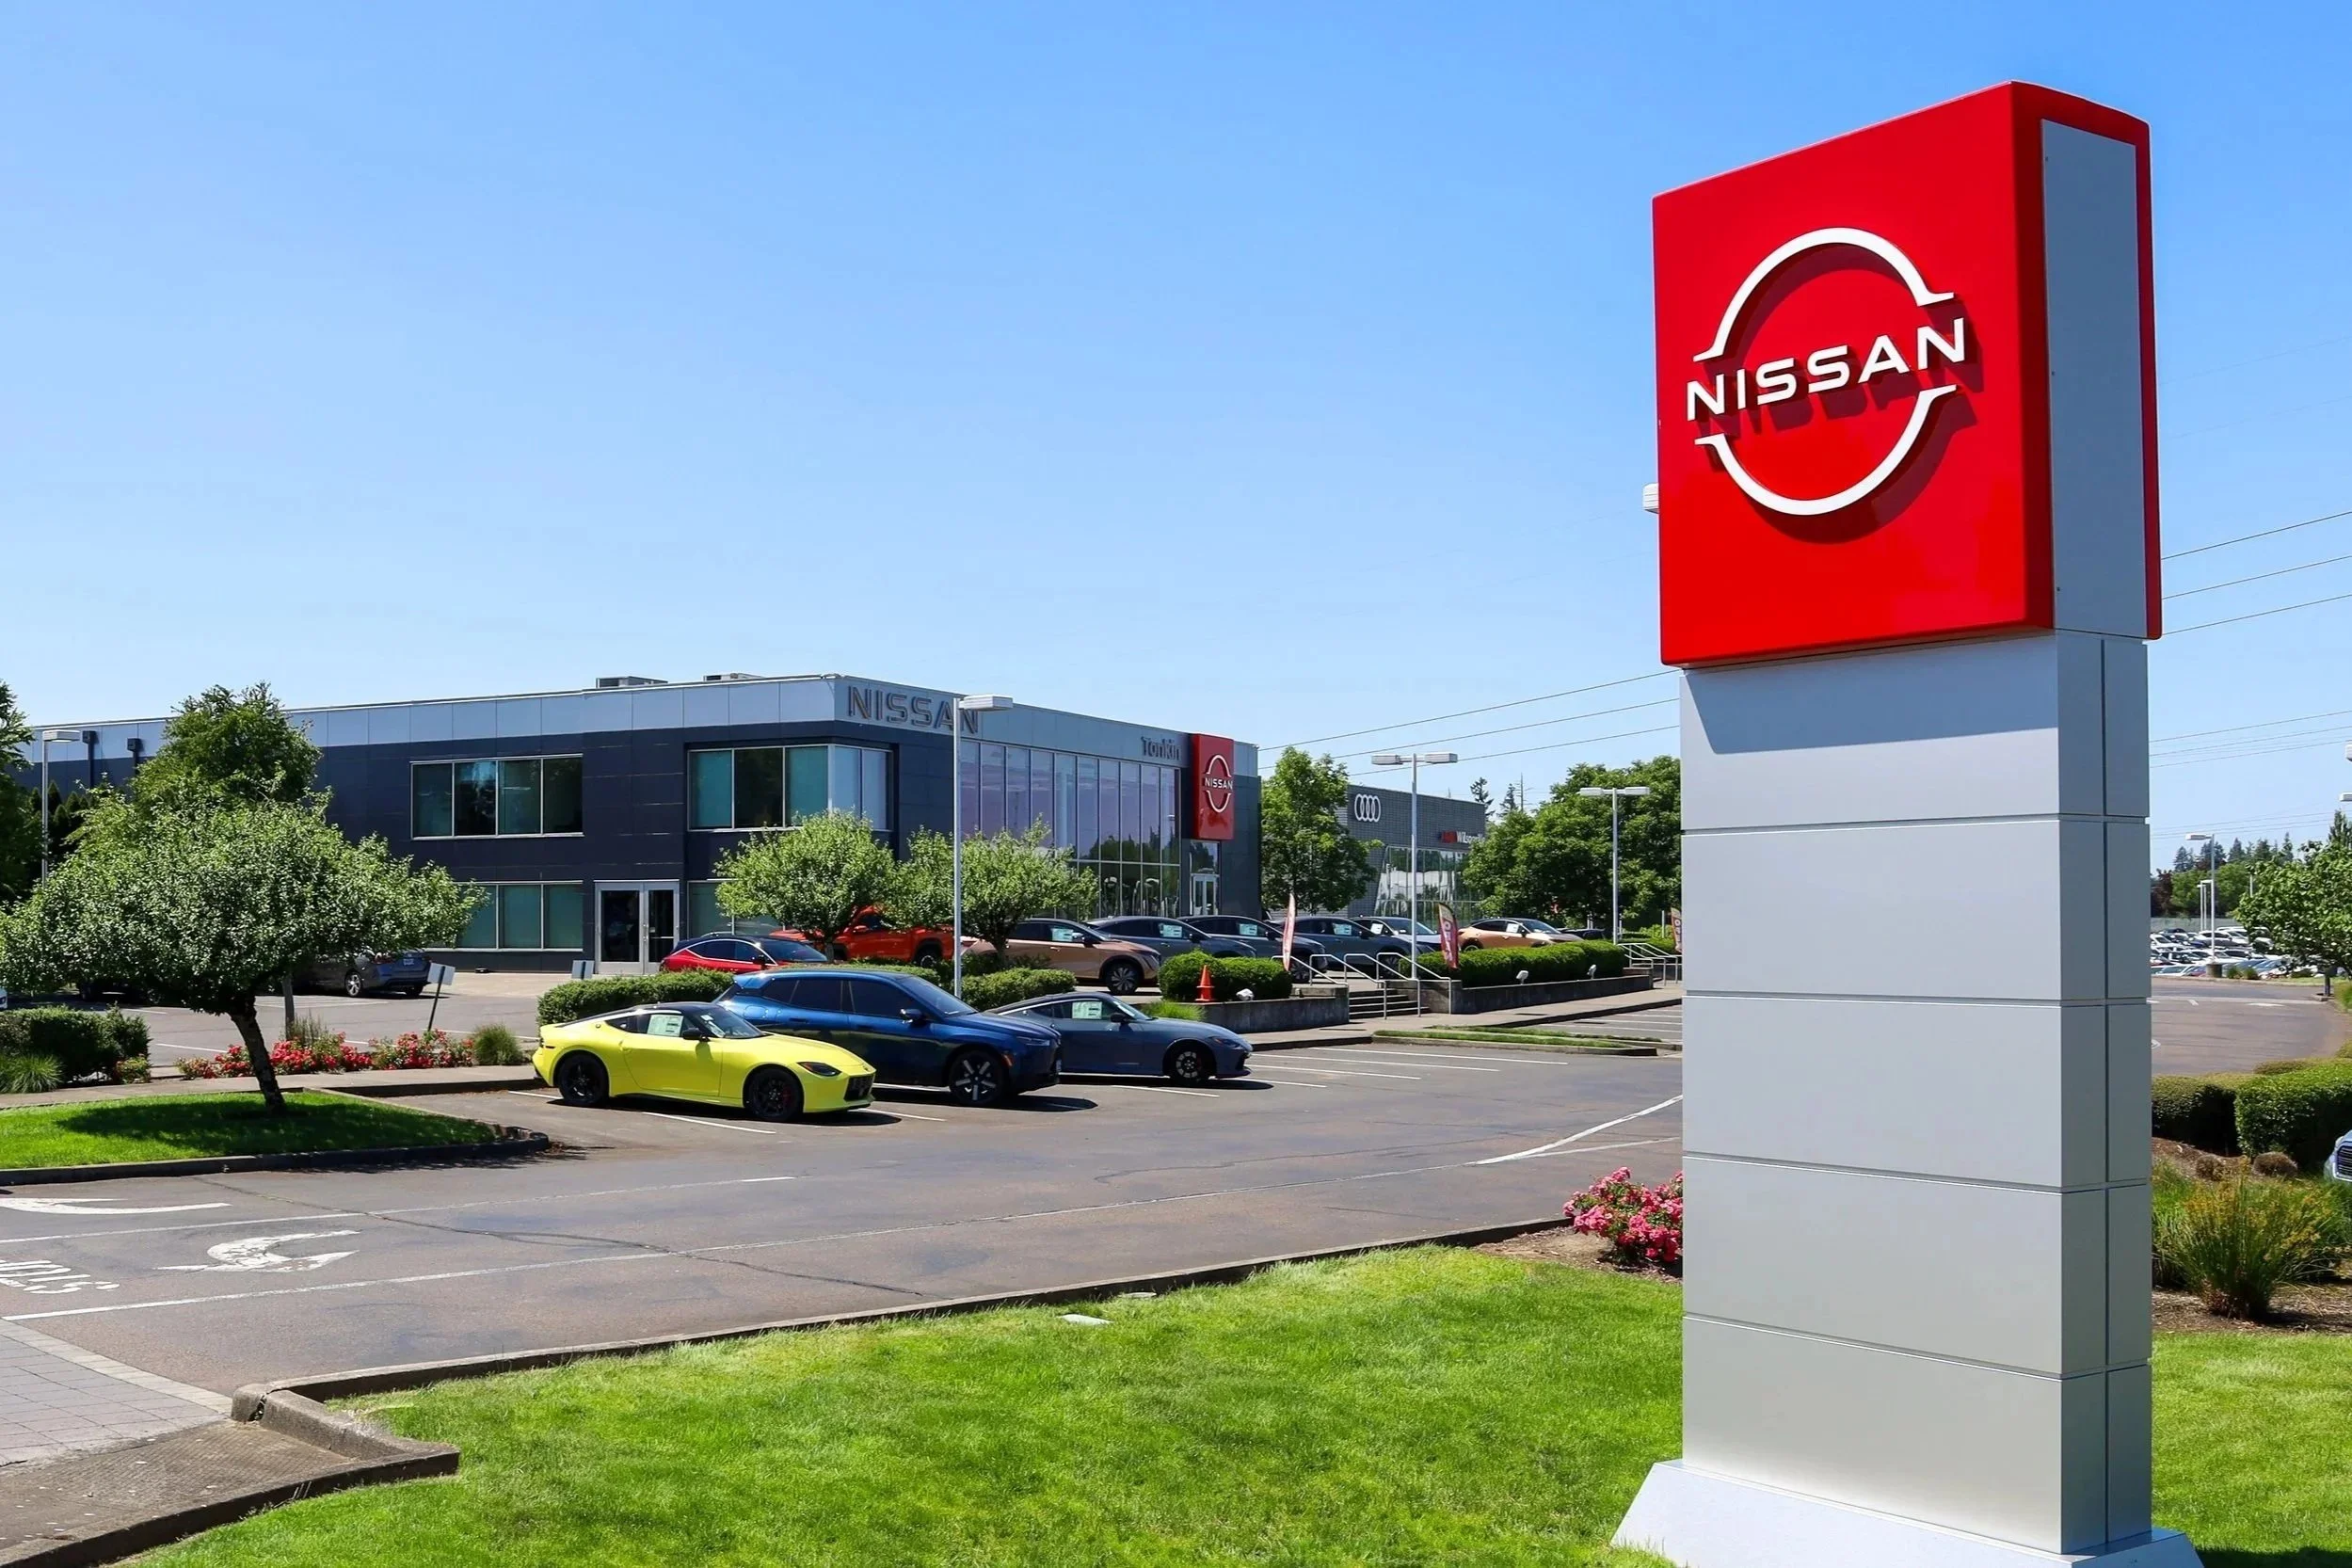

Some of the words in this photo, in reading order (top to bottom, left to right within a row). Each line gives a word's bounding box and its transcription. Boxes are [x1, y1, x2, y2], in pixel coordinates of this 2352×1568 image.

[1687, 317, 1965, 422] NISSAN
[849, 685, 979, 734] NISSAN
[1141, 736, 1181, 761] Tonkin
[1205, 777, 1233, 790] NISSAN
